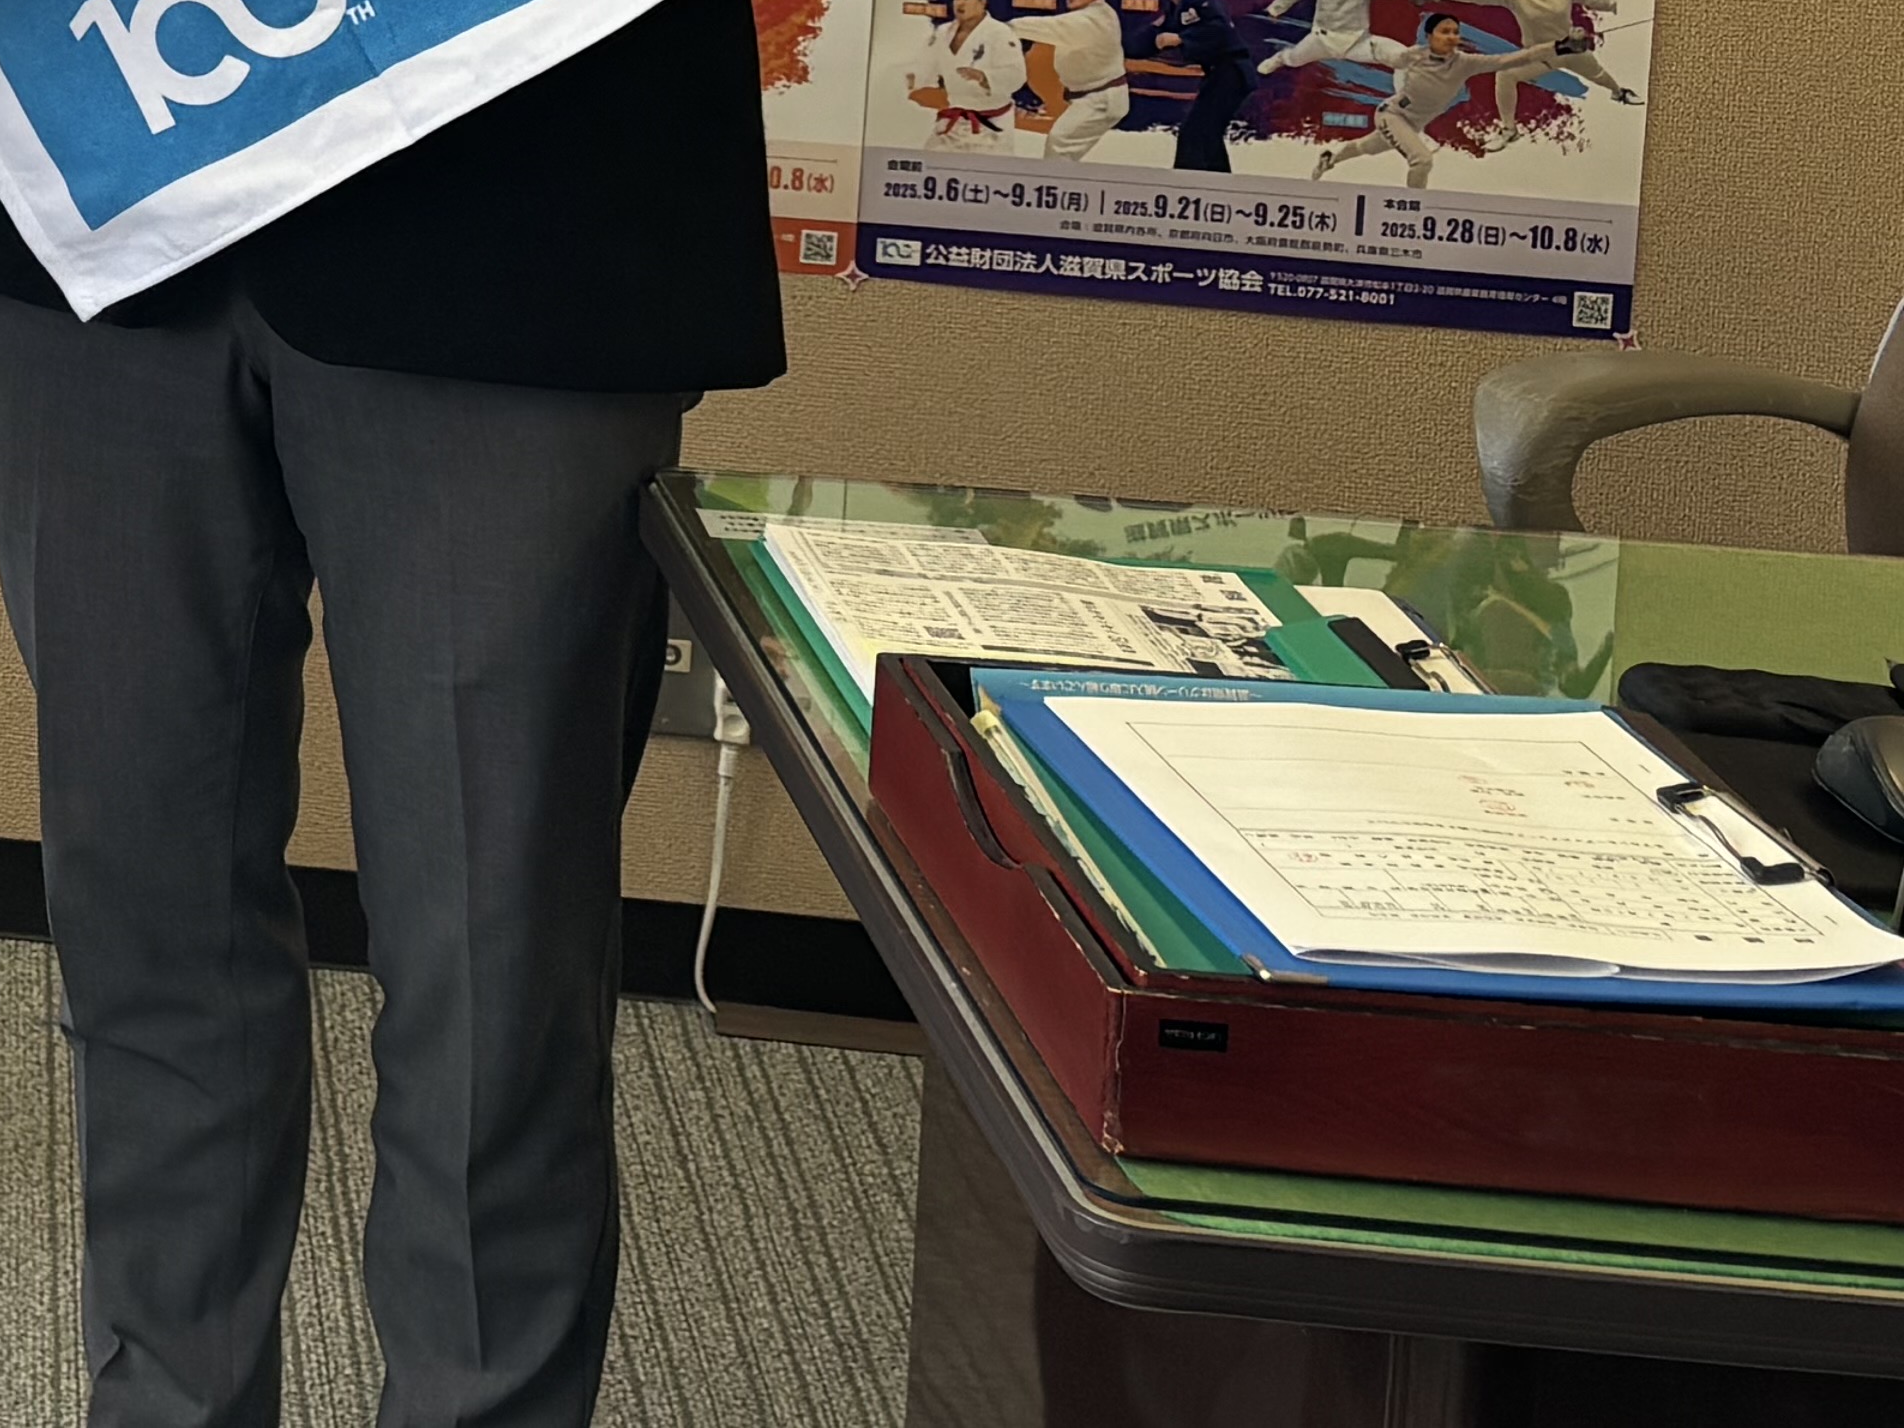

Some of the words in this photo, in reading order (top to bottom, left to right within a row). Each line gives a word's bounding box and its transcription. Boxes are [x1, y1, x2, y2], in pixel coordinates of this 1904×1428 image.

[925, 243, 1264, 293] 公益財団法人滋賀県スポーツ協会
